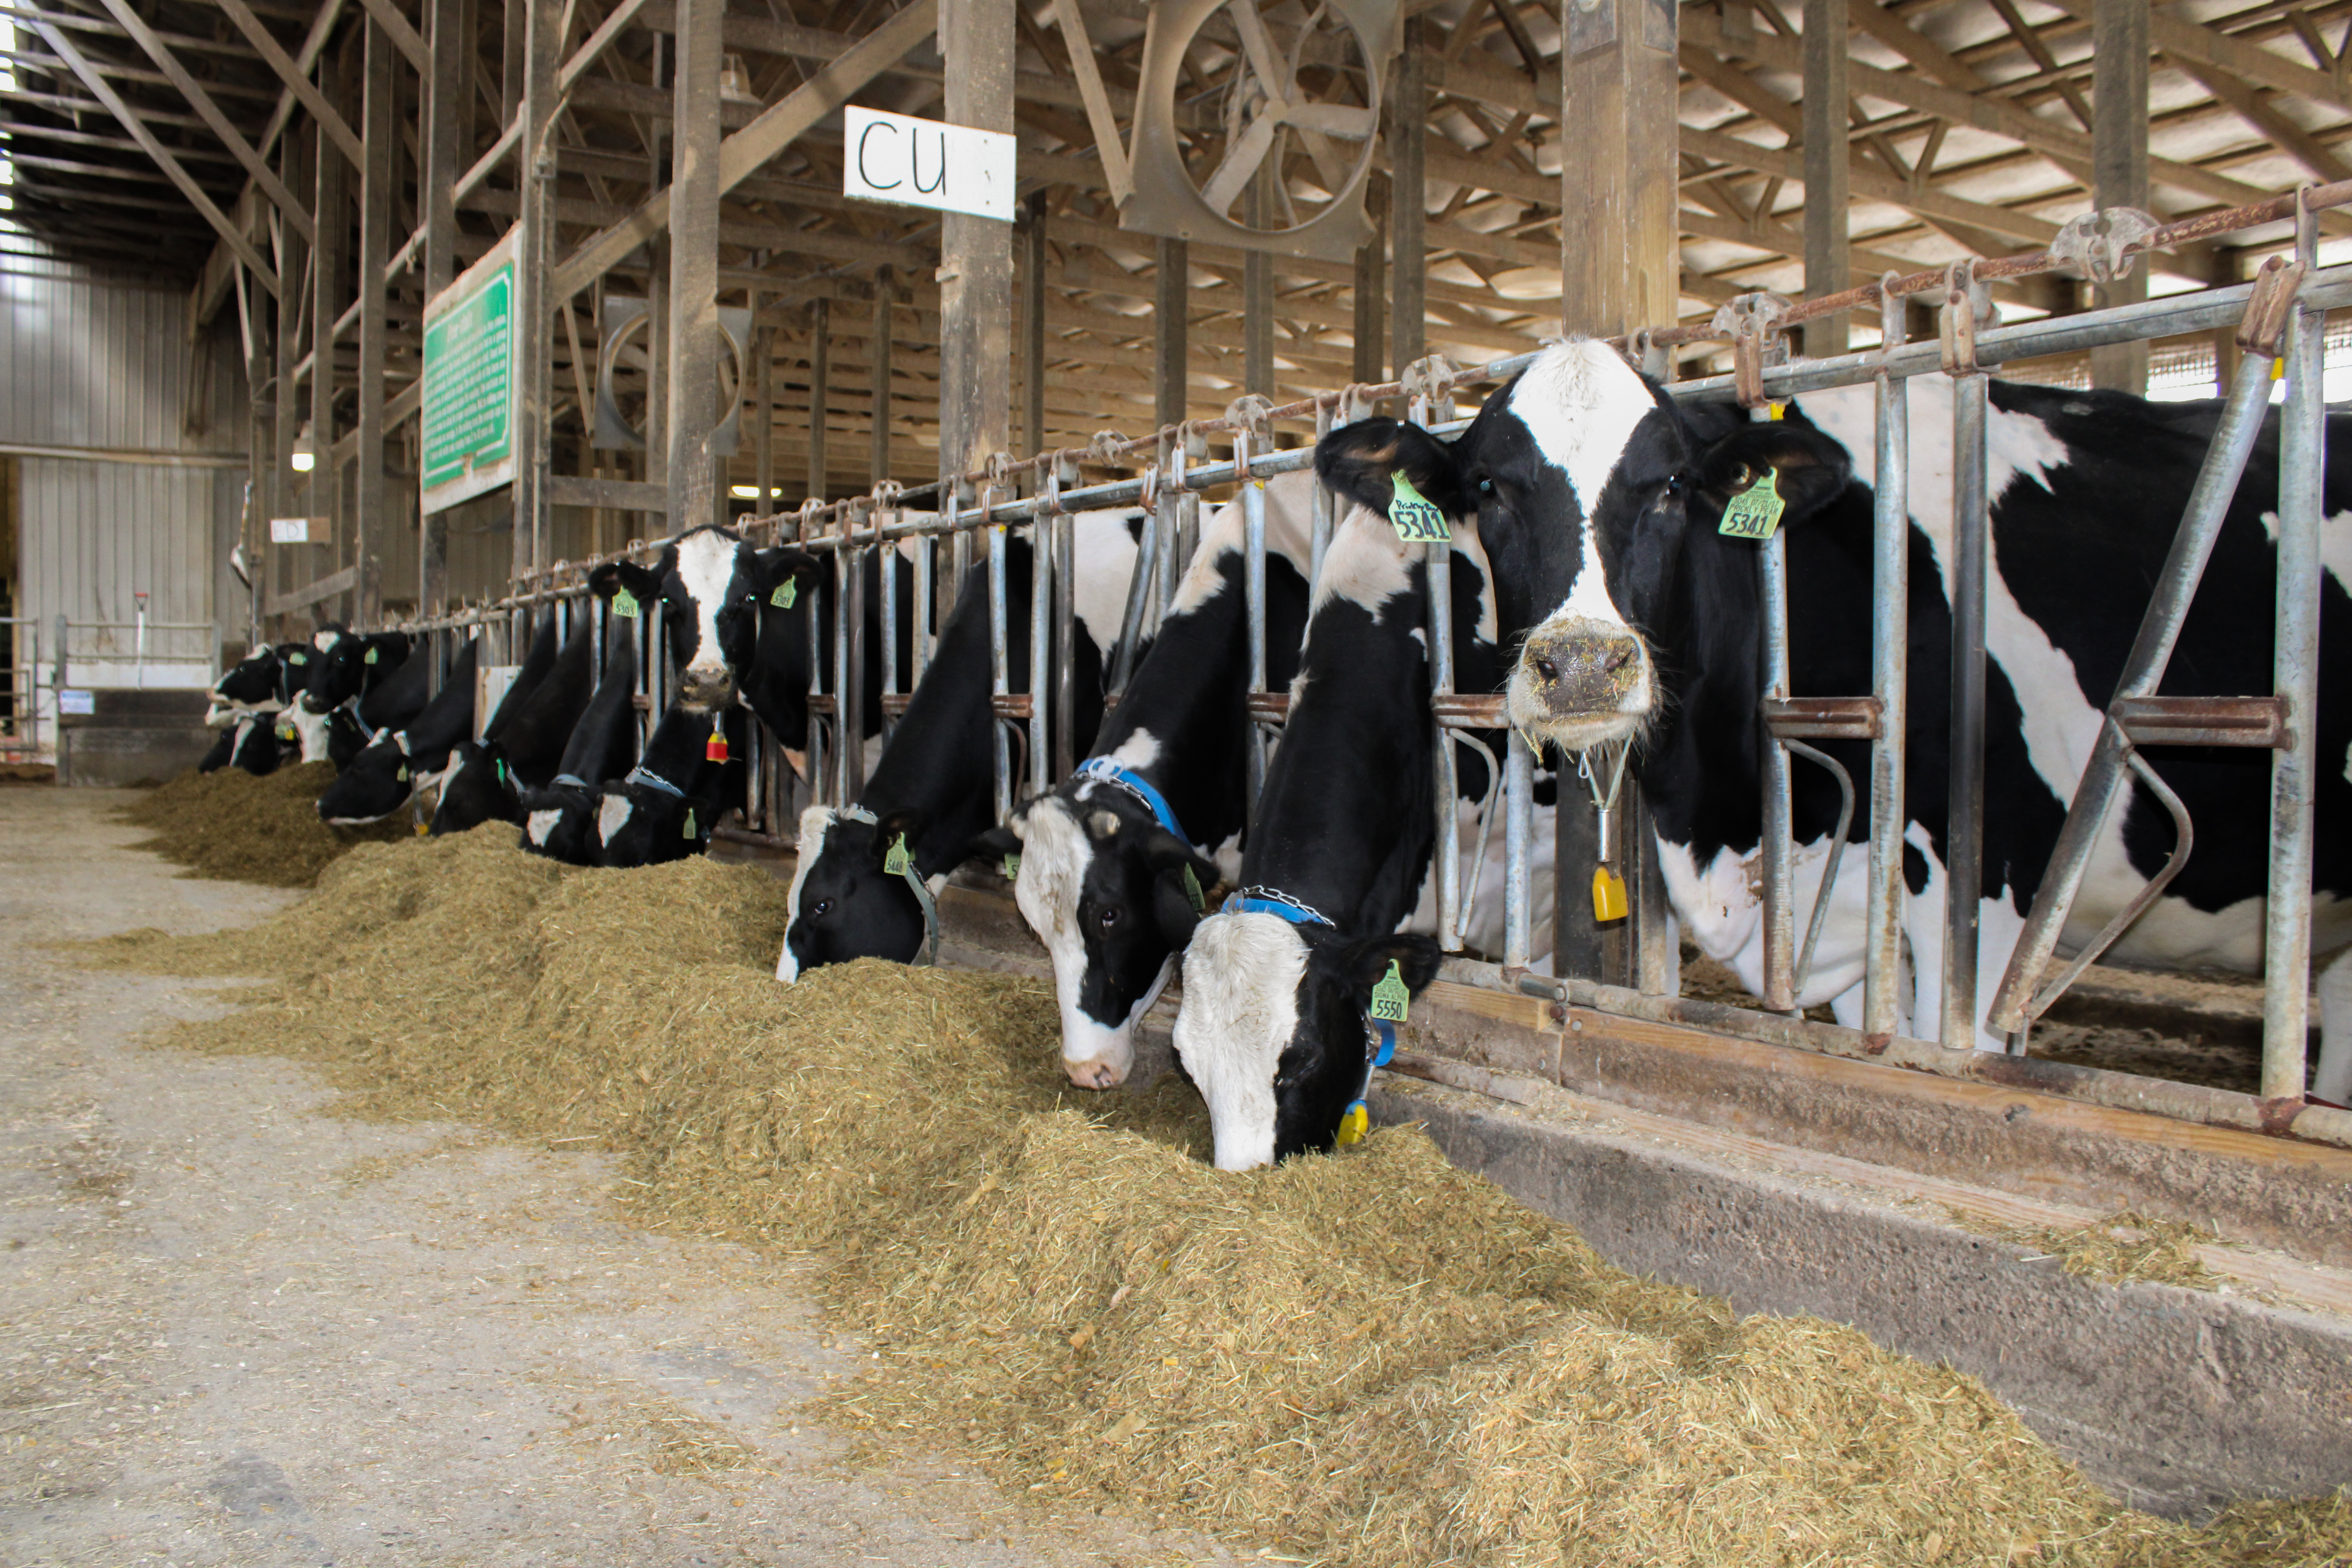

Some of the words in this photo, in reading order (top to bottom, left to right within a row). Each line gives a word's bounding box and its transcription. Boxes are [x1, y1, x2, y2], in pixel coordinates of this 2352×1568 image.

[1760, 506, 1779, 515] PEAR
[1393, 510, 1451, 540] 5341
[1726, 512, 1769, 535] 5341
[616, 604, 634, 616] 5303
[1376, 1000, 1402, 1019] 5550
